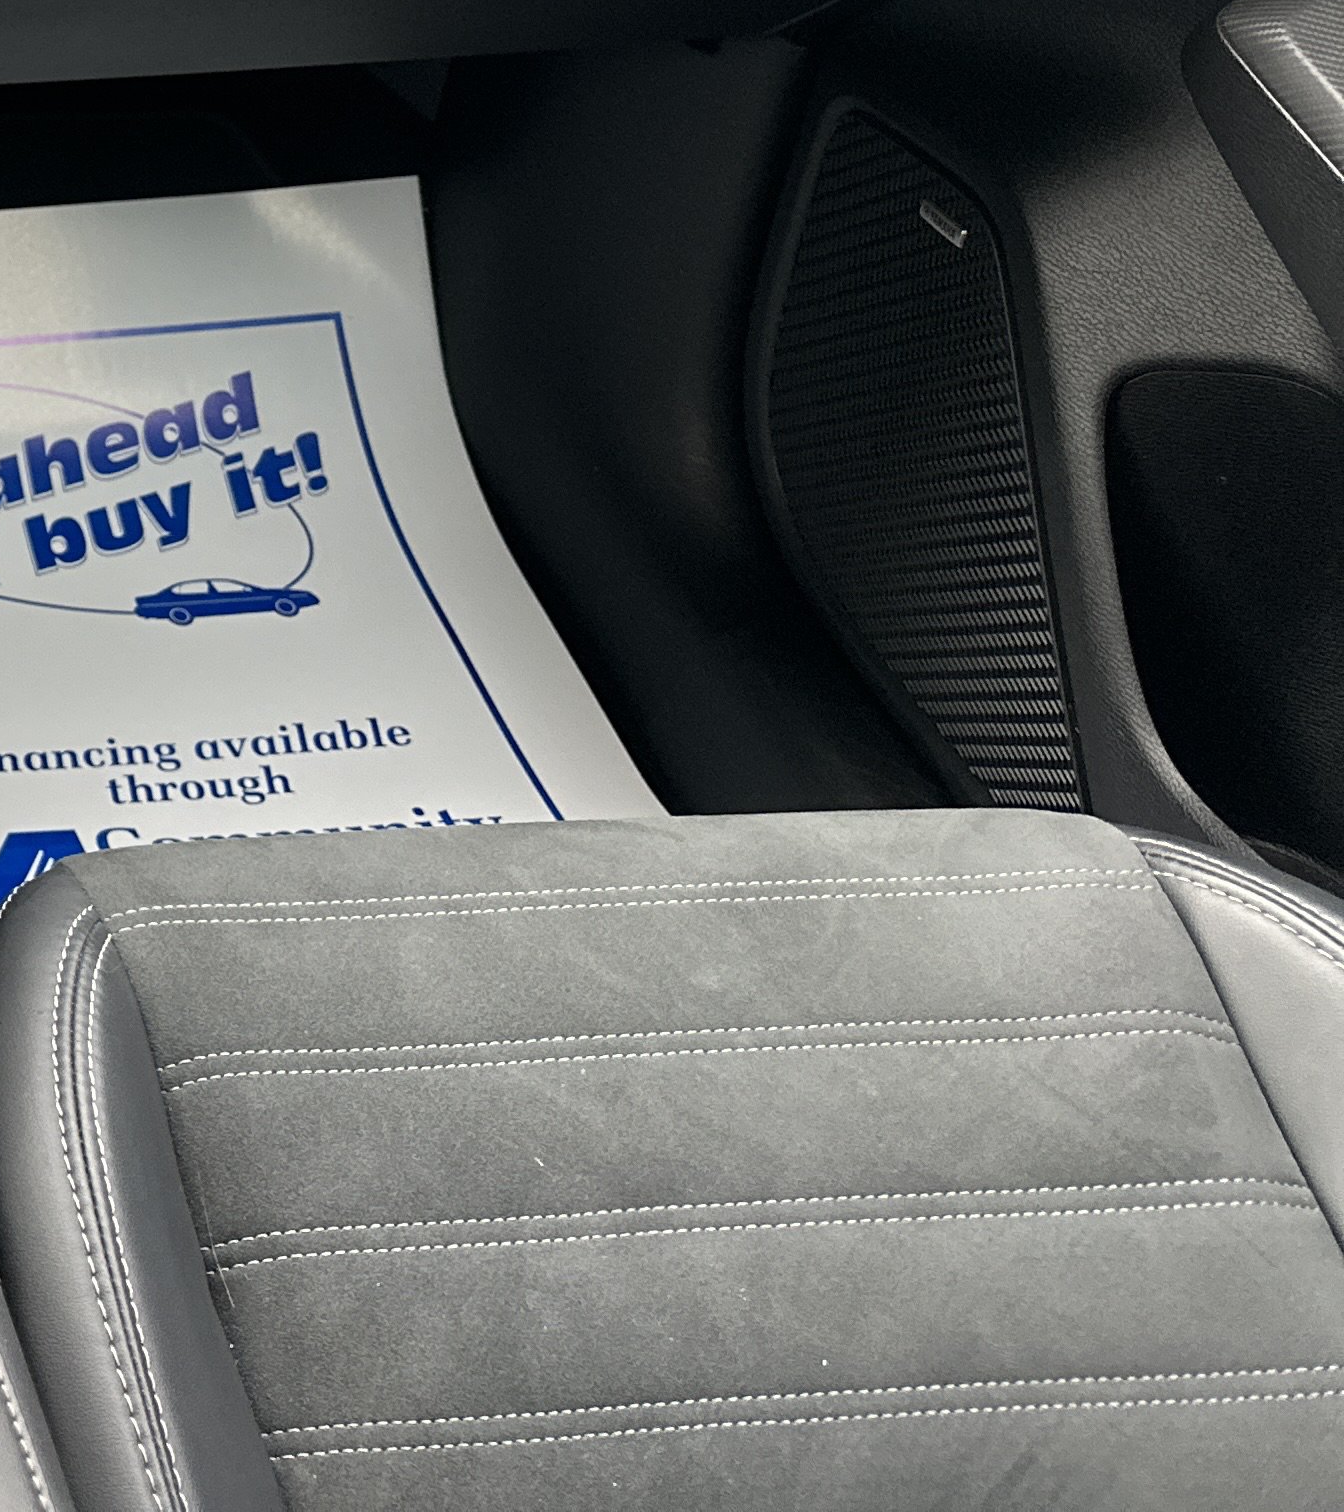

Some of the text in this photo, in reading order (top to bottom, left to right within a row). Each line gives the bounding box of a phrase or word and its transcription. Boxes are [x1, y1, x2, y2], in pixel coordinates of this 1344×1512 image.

[24, 481, 193, 575] buy
[221, 430, 329, 517] it!
[193, 716, 413, 763] available
[106, 764, 295, 807] through
